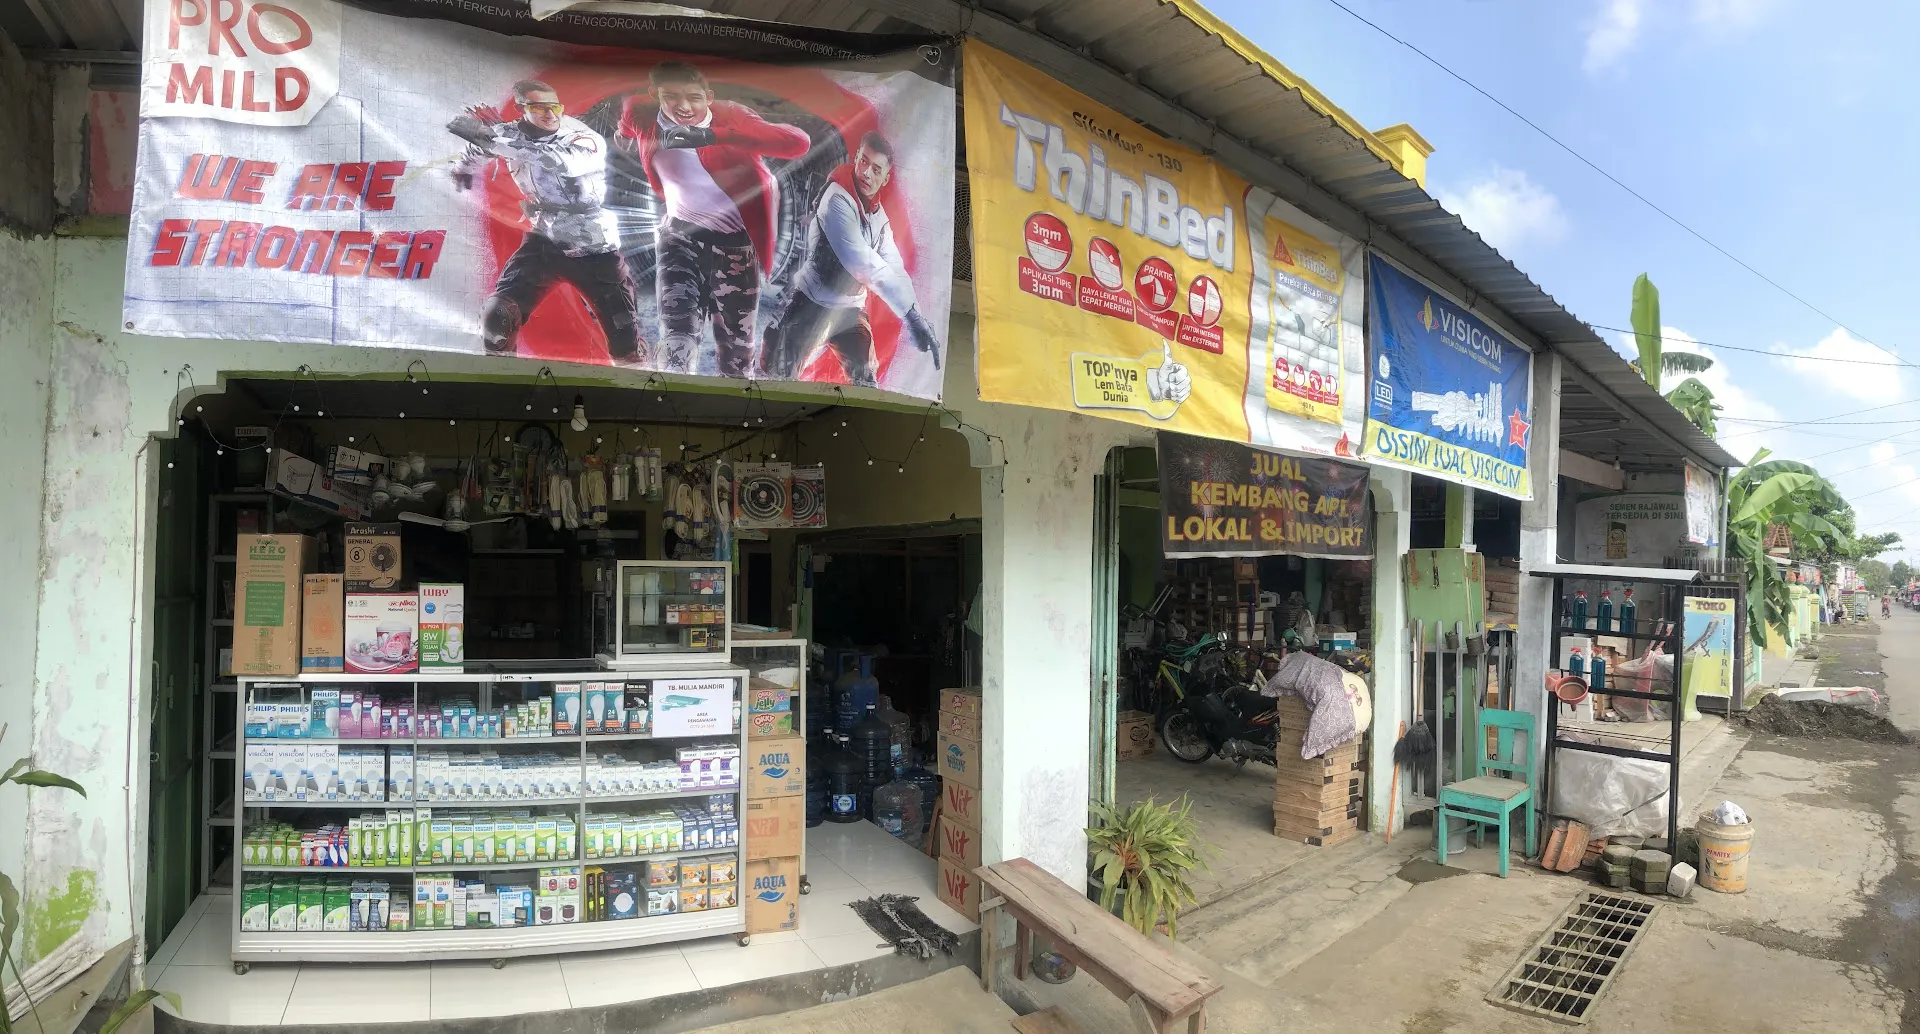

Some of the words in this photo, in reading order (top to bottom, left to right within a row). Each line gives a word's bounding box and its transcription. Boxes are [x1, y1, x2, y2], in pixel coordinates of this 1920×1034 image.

[167, 0, 313, 57] PRO
[456, 0, 512, 18] TERKENA
[515, 10, 565, 23] KAER
[664, 22, 711, 35] LAYANAN
[713, 25, 760, 41] BERHENTI
[761, 32, 809, 51] MEROKOK
[165, 63, 310, 112] MILD
[1157, 152, 1183, 173] 130
[177, 154, 279, 204] WE
[288, 161, 407, 212] ARE
[1000, 102, 1235, 273] ThinBed
[1032, 222, 1062, 242] 3mm
[148, 219, 447, 280] STRONGER
[1143, 264, 1173, 282] PRAKTIS
[1293, 248, 1339, 284] ThinBed
[1022, 266, 1054, 283] APLIKASI
[1055, 275, 1072, 289] TIPIS
[1032, 279, 1064, 300] 3mm
[1082, 286, 1098, 298] DAYA
[1099, 291, 1118, 303] LEKAT
[1081, 296, 1102, 307] CEPAT
[1103, 300, 1133, 316] MEREKAT
[1182, 333, 1192, 342] dan
[1192, 336, 1219, 349] EKSTERIOR
[1440, 308, 1502, 364] VISICOM
[1083, 359, 1138, 382] TOP'nya
[1095, 378, 1114, 390] Lem
[1116, 380, 1133, 392] Bata
[1376, 383, 1392, 402] LED
[1103, 390, 1129, 403] Dunia
[1251, 452, 1307, 482] JUAL
[1433, 443, 1467, 475] JUAL
[1470, 453, 1521, 489] VISICOM
[1190, 480, 1310, 513] KEMBANG
[1314, 494, 1350, 518] API
[1609, 503, 1637, 511] SEMEN
[1638, 503, 1680, 511] RAJAWALI
[1605, 511, 1650, 520] TERSEDIA
[1651, 512, 1663, 520] DI
[1664, 512, 1684, 520] SINI
[350, 526, 376, 535] Arashi
[1167, 515, 1252, 541] LOKAL
[1260, 519, 1285, 541] &
[1286, 521, 1364, 546] IMPORT
[249, 545, 286, 554] HERO
[423, 588, 449, 597] LUBY
[1696, 600, 1726, 612] TOKO
[423, 632, 438, 641] 8W
[754, 697, 775, 710] jelly
[759, 752, 791, 767] AQUA
[948, 783, 973, 818] Vit
[944, 824, 970, 859] Vit
[753, 874, 787, 890] AQUA
[944, 868, 970, 904] Vit
